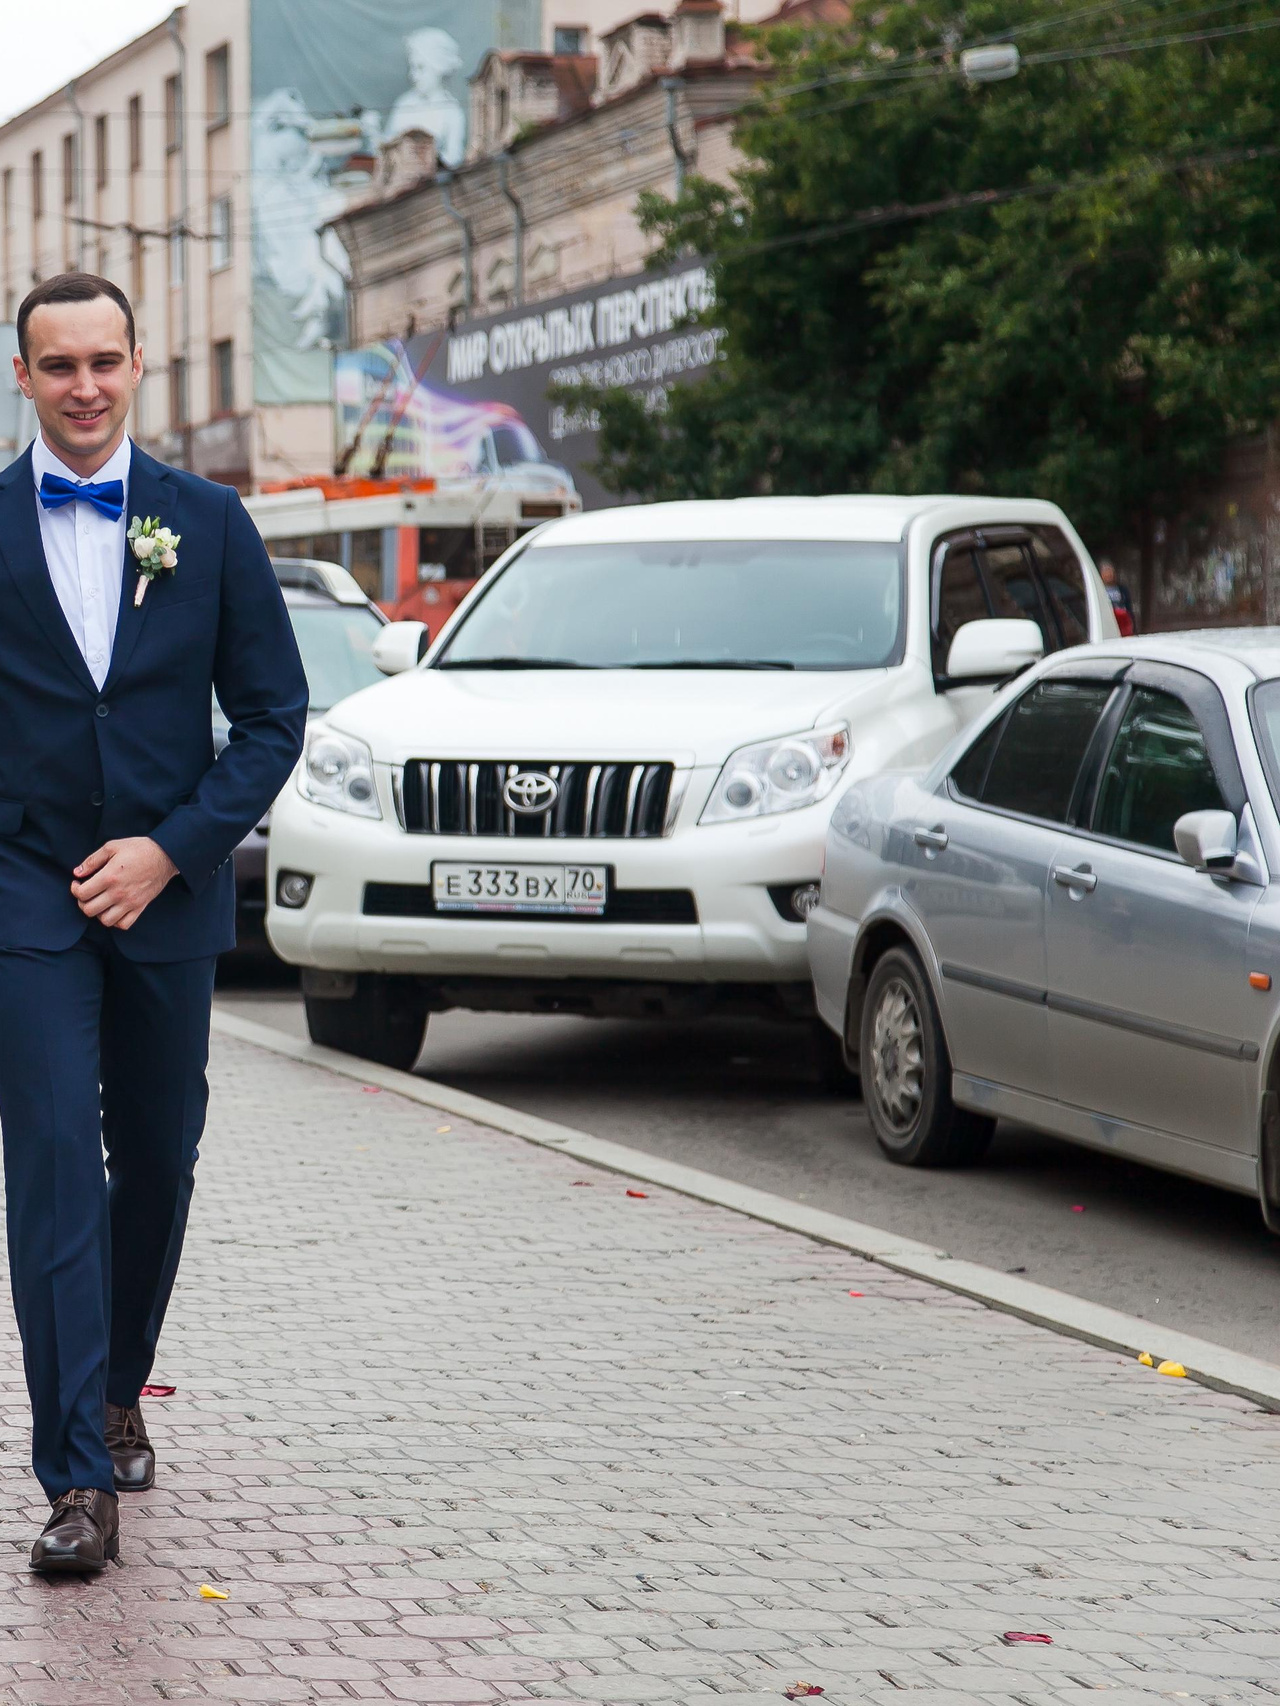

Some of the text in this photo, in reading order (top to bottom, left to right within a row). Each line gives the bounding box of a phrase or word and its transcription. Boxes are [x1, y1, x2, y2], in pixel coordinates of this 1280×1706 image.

[447, 331, 488, 383] МИР
[490, 303, 595, 374] ОТКРЫТЫХ
[568, 869, 595, 891] 70
